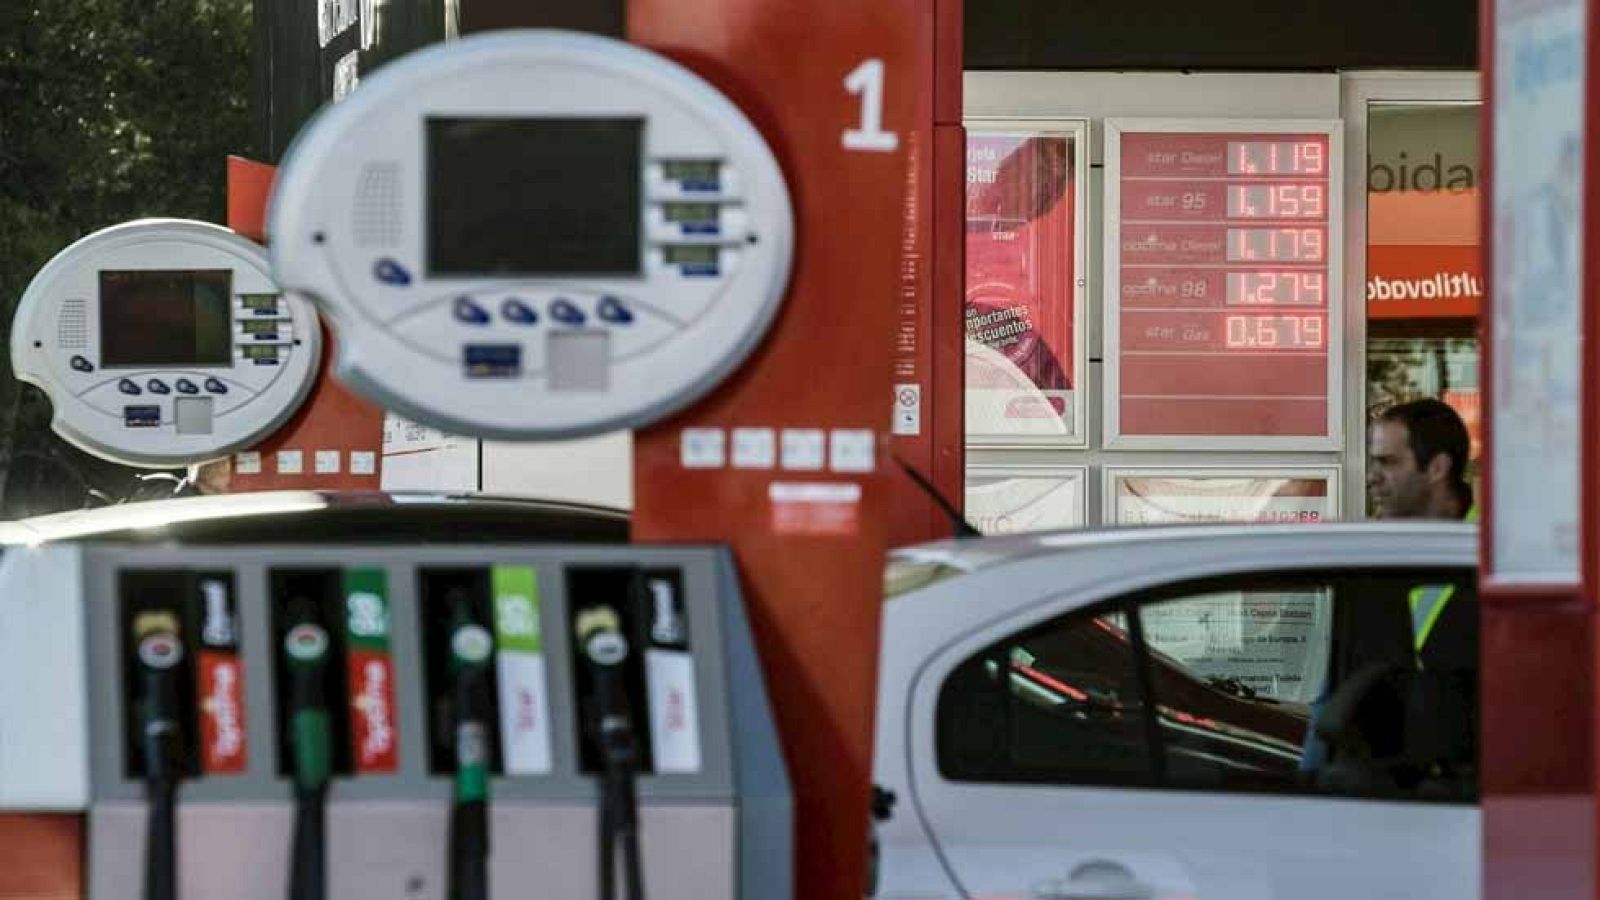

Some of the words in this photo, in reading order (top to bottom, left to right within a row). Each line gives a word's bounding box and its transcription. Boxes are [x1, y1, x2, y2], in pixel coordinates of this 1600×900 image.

[842, 58, 899, 151] 1
[1181, 192, 1207, 210] 95
[1239, 185, 1322, 216] 1.159
[1239, 228, 1322, 259] 1.179
[1181, 280, 1207, 298] 98
[1239, 272, 1322, 303] 1.274
[1227, 316, 1322, 347] 0.679
